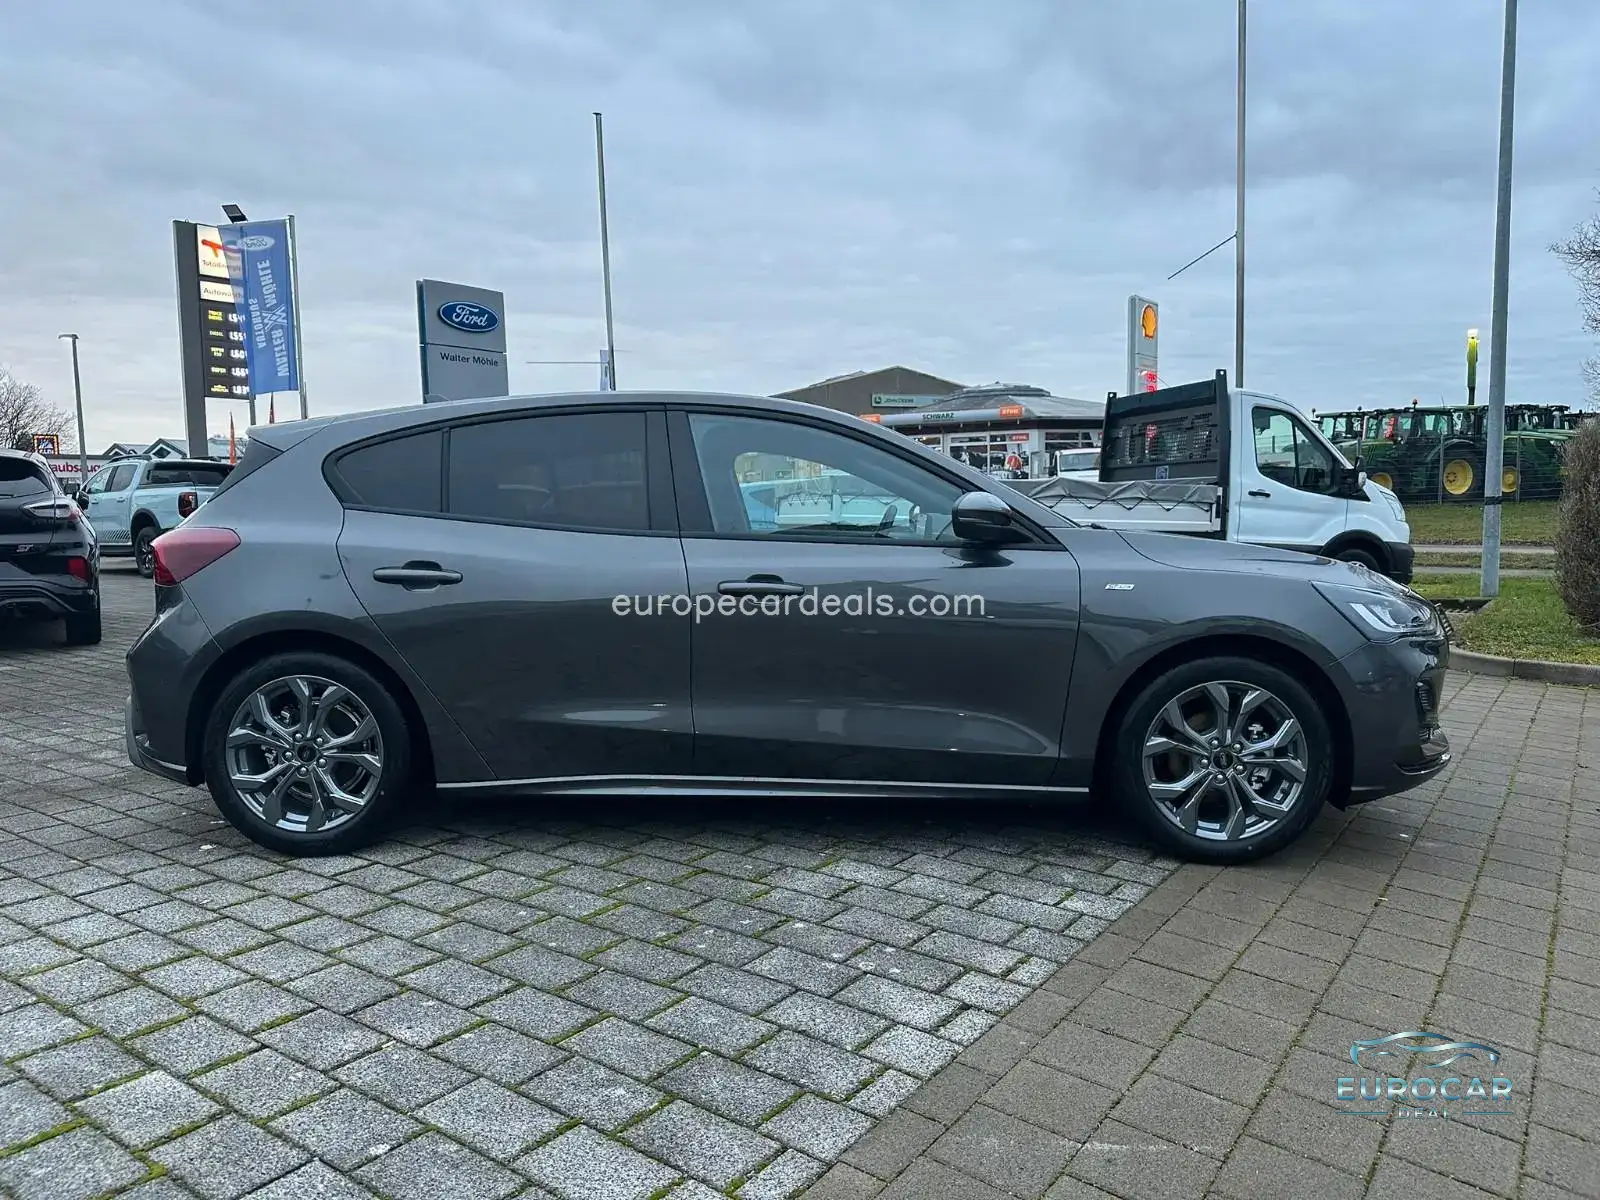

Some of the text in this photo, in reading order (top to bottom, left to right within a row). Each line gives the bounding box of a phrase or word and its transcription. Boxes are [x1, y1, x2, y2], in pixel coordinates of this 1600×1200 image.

[452, 304, 489, 327] Ford
[440, 352, 499, 367] Walter Möhle
[922, 412, 955, 420] SCHWARZ
